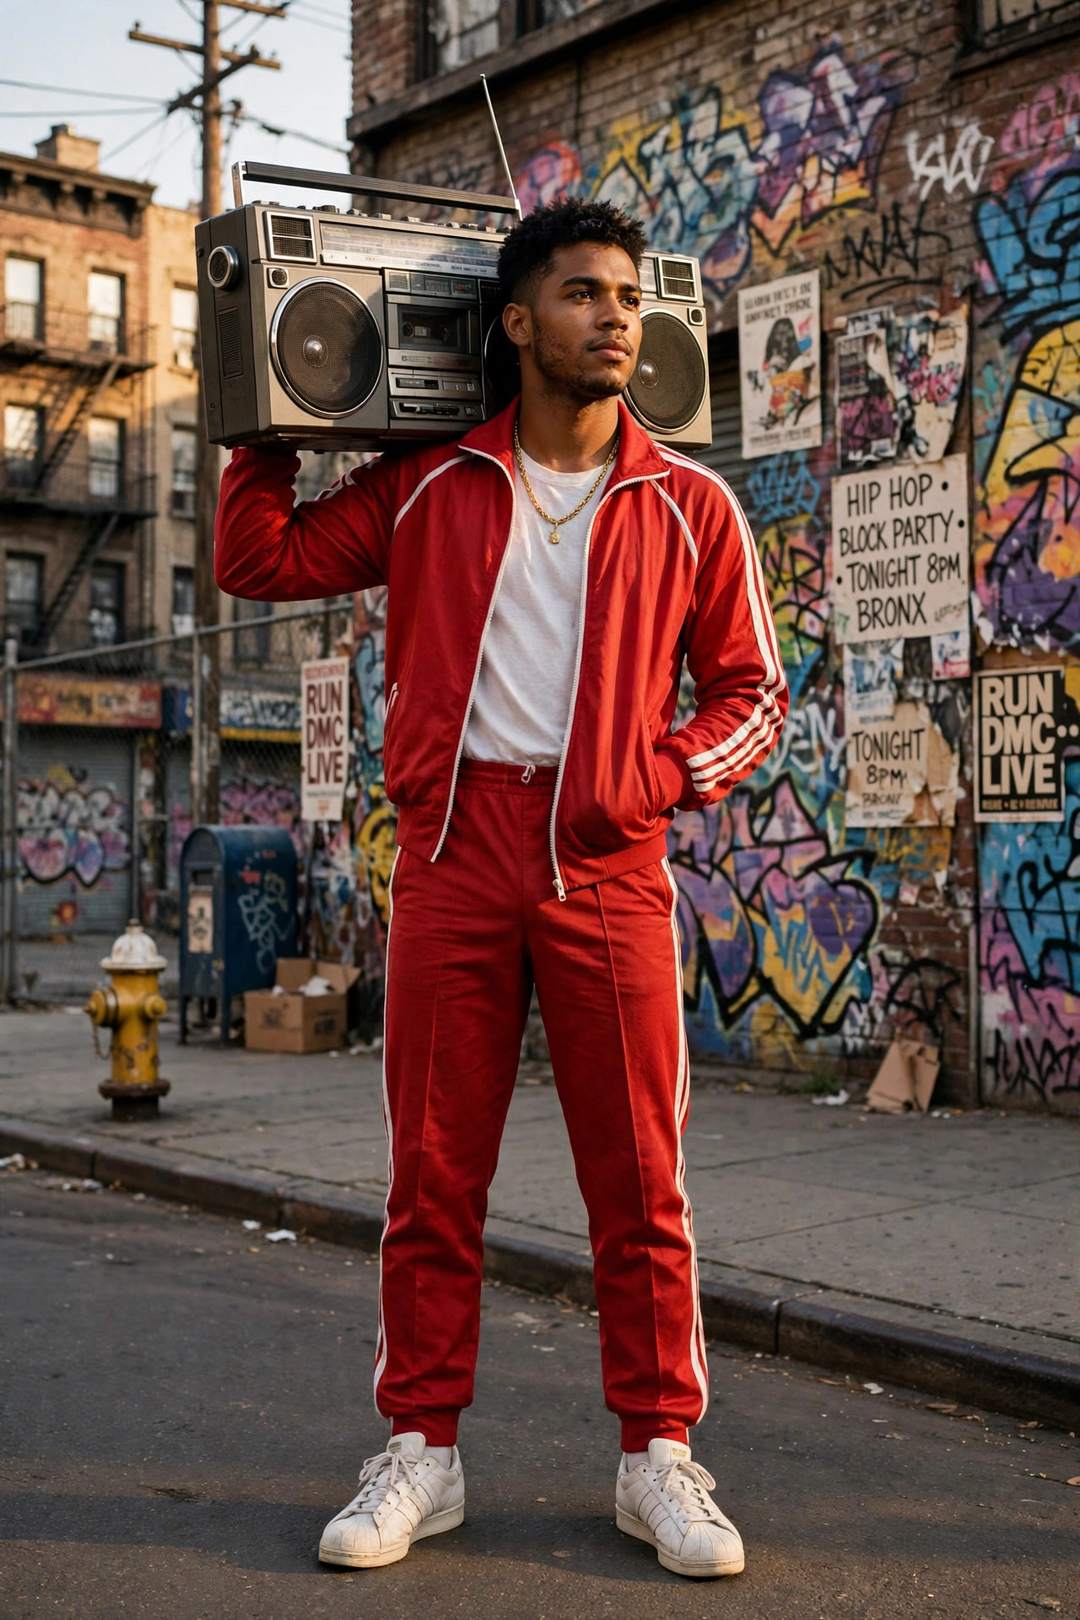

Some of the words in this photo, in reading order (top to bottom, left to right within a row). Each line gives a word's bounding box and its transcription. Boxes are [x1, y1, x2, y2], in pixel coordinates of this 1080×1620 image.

[847, 481, 881, 517] HIP
[889, 473, 933, 510] HOP
[838, 520, 888, 557] BLOCK
[892, 509, 954, 549] PARTY
[846, 554, 921, 593] TONIGHT
[927, 552, 961, 584] 8PM
[857, 591, 927, 633] BRONX
[306, 680, 343, 715] RUN
[981, 673, 1054, 716] RUN
[306, 715, 344, 750] DMC
[851, 728, 926, 763] TONIGHT
[982, 712, 1056, 756] DMC
[307, 750, 343, 785] LIVE
[982, 753, 1056, 795] LIVE
